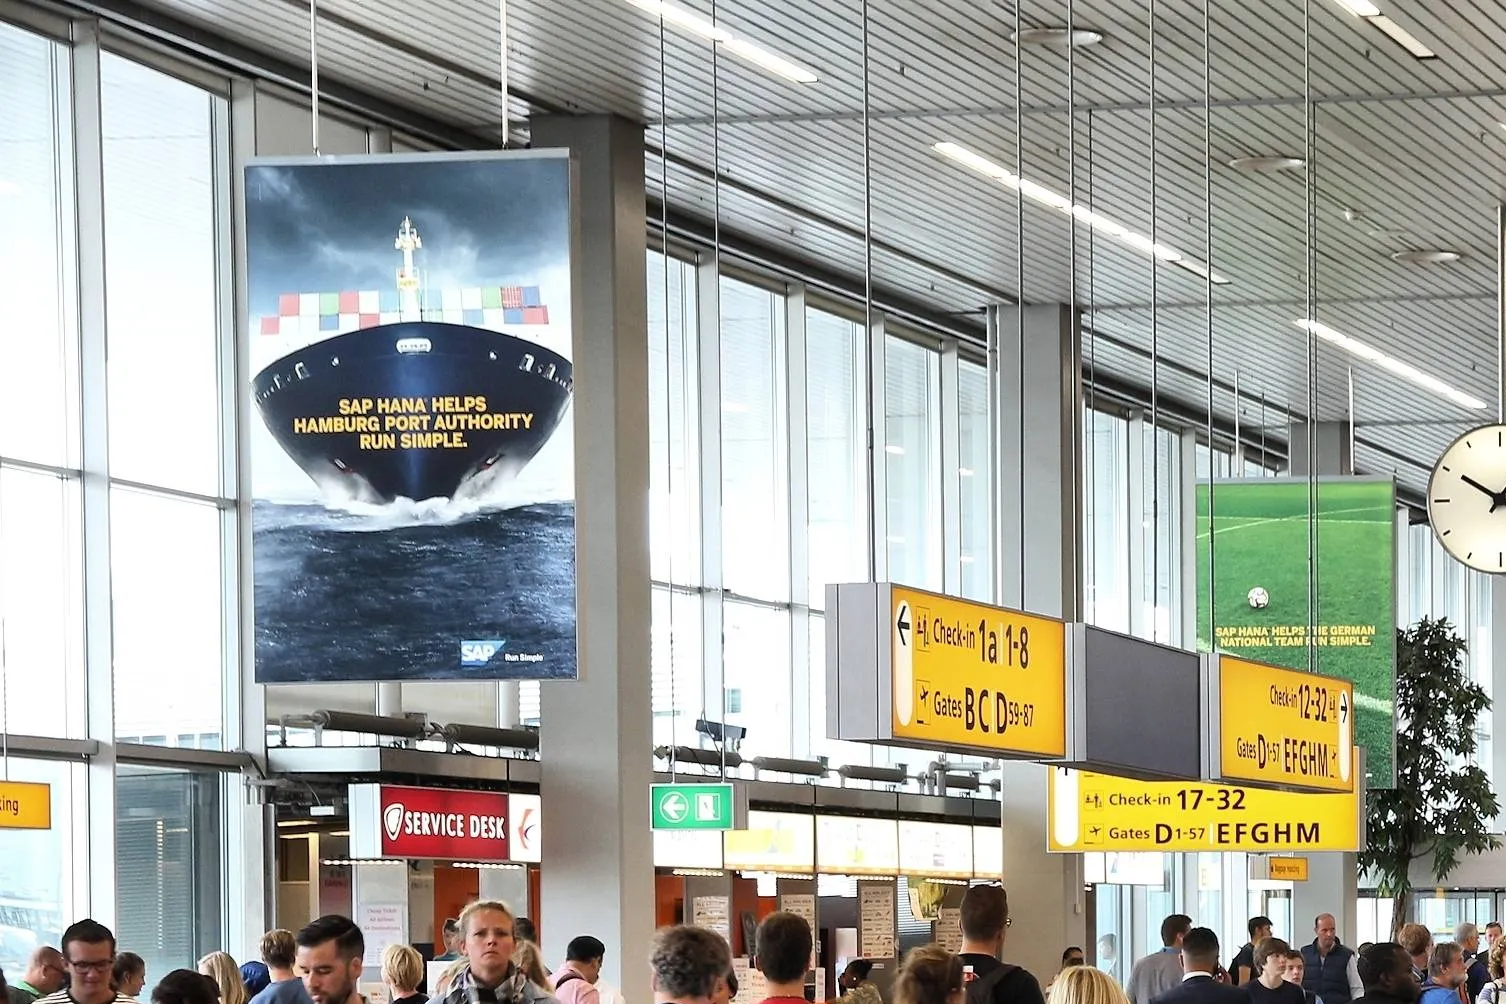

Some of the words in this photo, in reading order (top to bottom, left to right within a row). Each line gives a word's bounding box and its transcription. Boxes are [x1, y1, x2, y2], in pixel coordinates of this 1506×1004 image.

[338, 398, 373, 415] SAP
[377, 397, 426, 414] HANA
[432, 395, 487, 413] HELPS
[294, 415, 380, 434] HAMBURG
[385, 414, 431, 432] PORT
[434, 413, 534, 431] AUTHORITY
[360, 433, 396, 450] RUN
[400, 432, 468, 449] SIMPLE.
[1215, 627, 1237, 637] SAP
[1238, 626, 1268, 637] HANA
[1272, 626, 1305, 636] HELPS
[1330, 625, 1376, 636] GERMAN
[1220, 636, 1273, 647] NATIONAL
[1274, 636, 1304, 647] TEAM
[1330, 636, 1371, 646] SIMPLE.
[461, 644, 495, 662] SAP
[933, 618, 975, 649] Check-in
[979, 619, 998, 664] 1a
[1005, 624, 1029, 669] 1-8
[934, 690, 962, 719] Gates
[1269, 684, 1298, 709] Check-in
[1299, 683, 1327, 722] 12-32
[1236, 737, 1257, 760] Gates
[0, 795, 19, 816] ing
[1108, 793, 1171, 807] Check-in
[1176, 788, 1246, 811] 17-32
[404, 811, 465, 838] SERVICE
[469, 814, 506, 840] DESK
[1109, 827, 1150, 840] Gates
